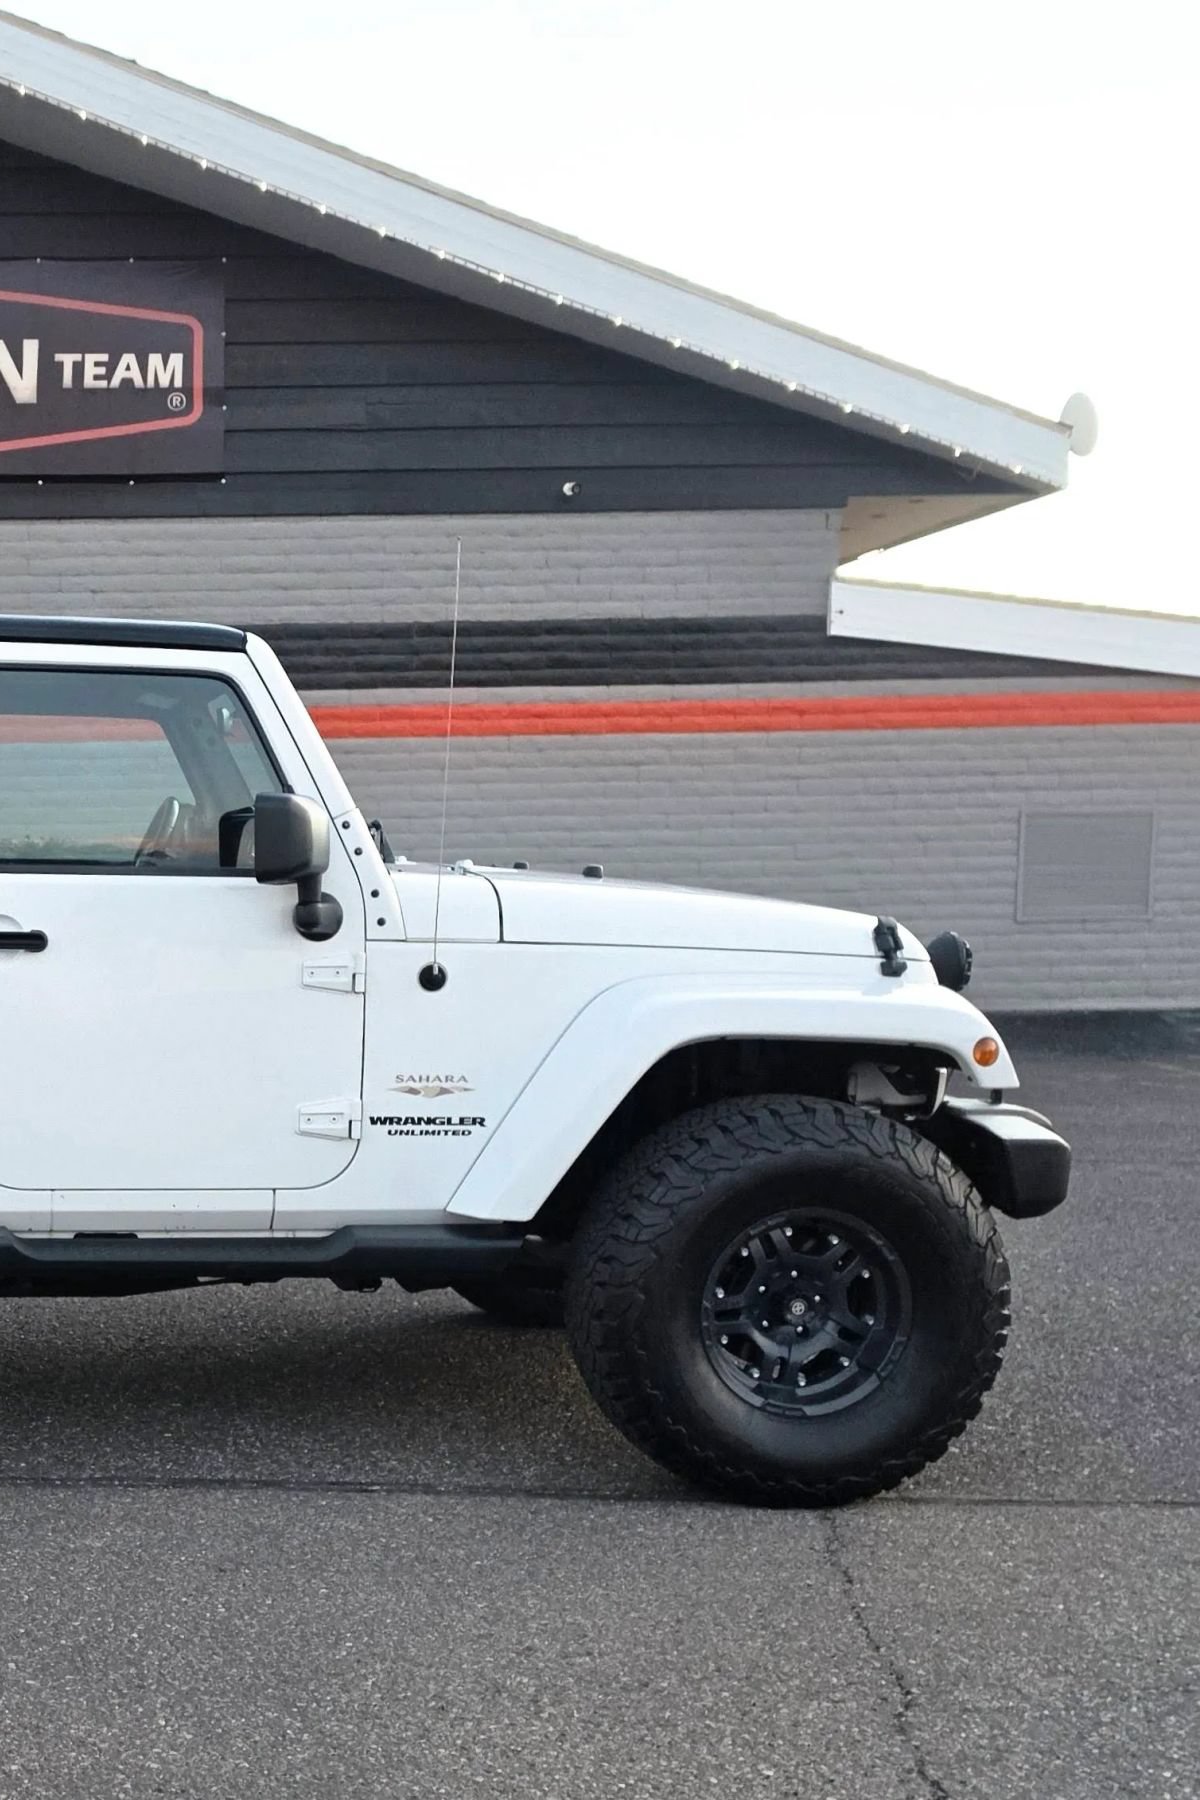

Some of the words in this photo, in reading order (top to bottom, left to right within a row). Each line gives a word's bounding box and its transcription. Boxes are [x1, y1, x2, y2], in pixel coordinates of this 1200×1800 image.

[54, 352, 184, 388] TEAM
[395, 1074, 469, 1084] SAHARA
[369, 1116, 487, 1127] WRANGLER
